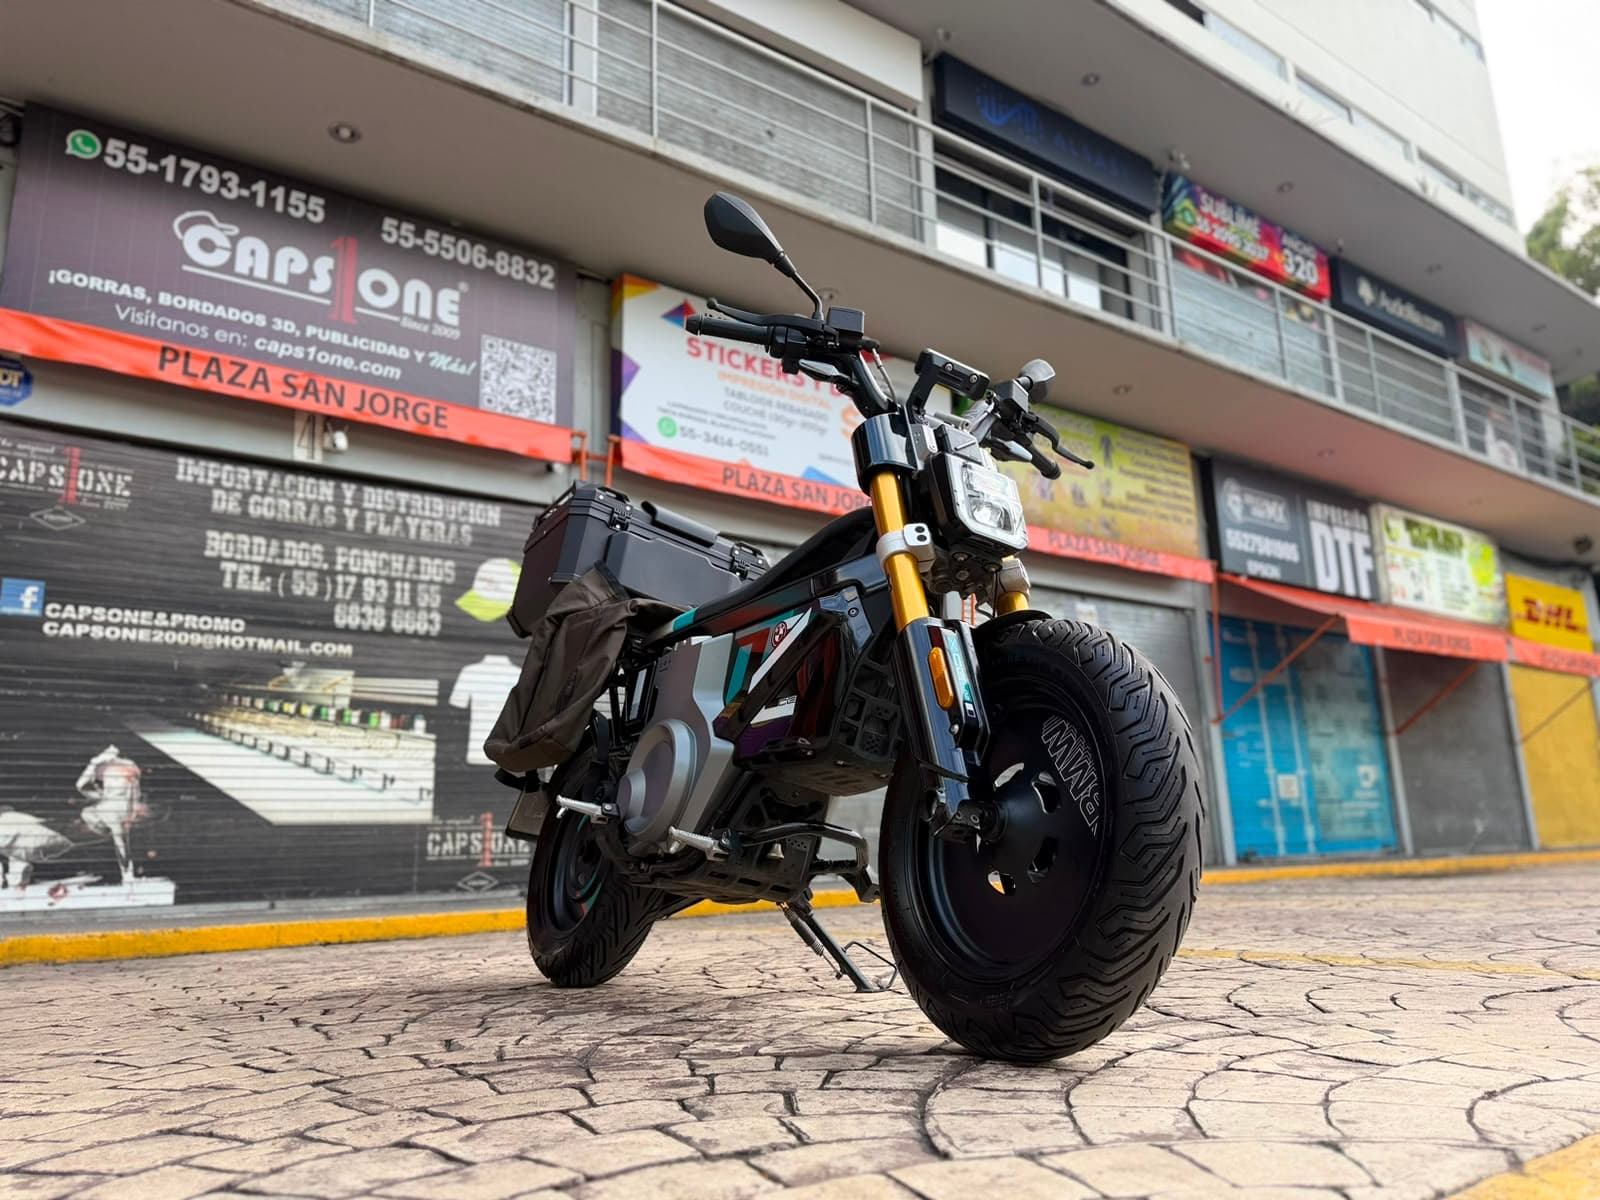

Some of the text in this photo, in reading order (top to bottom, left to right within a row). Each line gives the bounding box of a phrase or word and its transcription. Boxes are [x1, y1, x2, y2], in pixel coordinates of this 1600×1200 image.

[103, 137, 326, 223] 55-1793-1155
[380, 216, 556, 290] 55-5506-8832
[1283, 249, 1319, 287] 320
[48, 269, 477, 377] ¡GORRAS, BORDADOS 3D, PUBLICIDAD Y Más!
[115, 303, 209, 340] Visítanos
[254, 336, 402, 381] caps1one.com
[431, 322, 462, 341] 2009
[158, 345, 449, 430] PLAZA SAN JORGE
[175, 457, 502, 528] IMPORTACION Y DISTRIBUCION
[721, 465, 873, 511] PLAZA SAN JOR
[211, 489, 474, 547] DE GORRAS Y PLAYERAS
[219, 561, 273, 593] TEL:
[417, 583, 443, 609] 55
[334, 546, 457, 585] PONCHADOS
[1309, 520, 1375, 600] DTF
[42, 621, 354, 658] CAPSONE2009@HOTMAIL.COM
[45, 602, 247, 634] CAPSONE&PROMO
[1522, 596, 1578, 632] DHL
